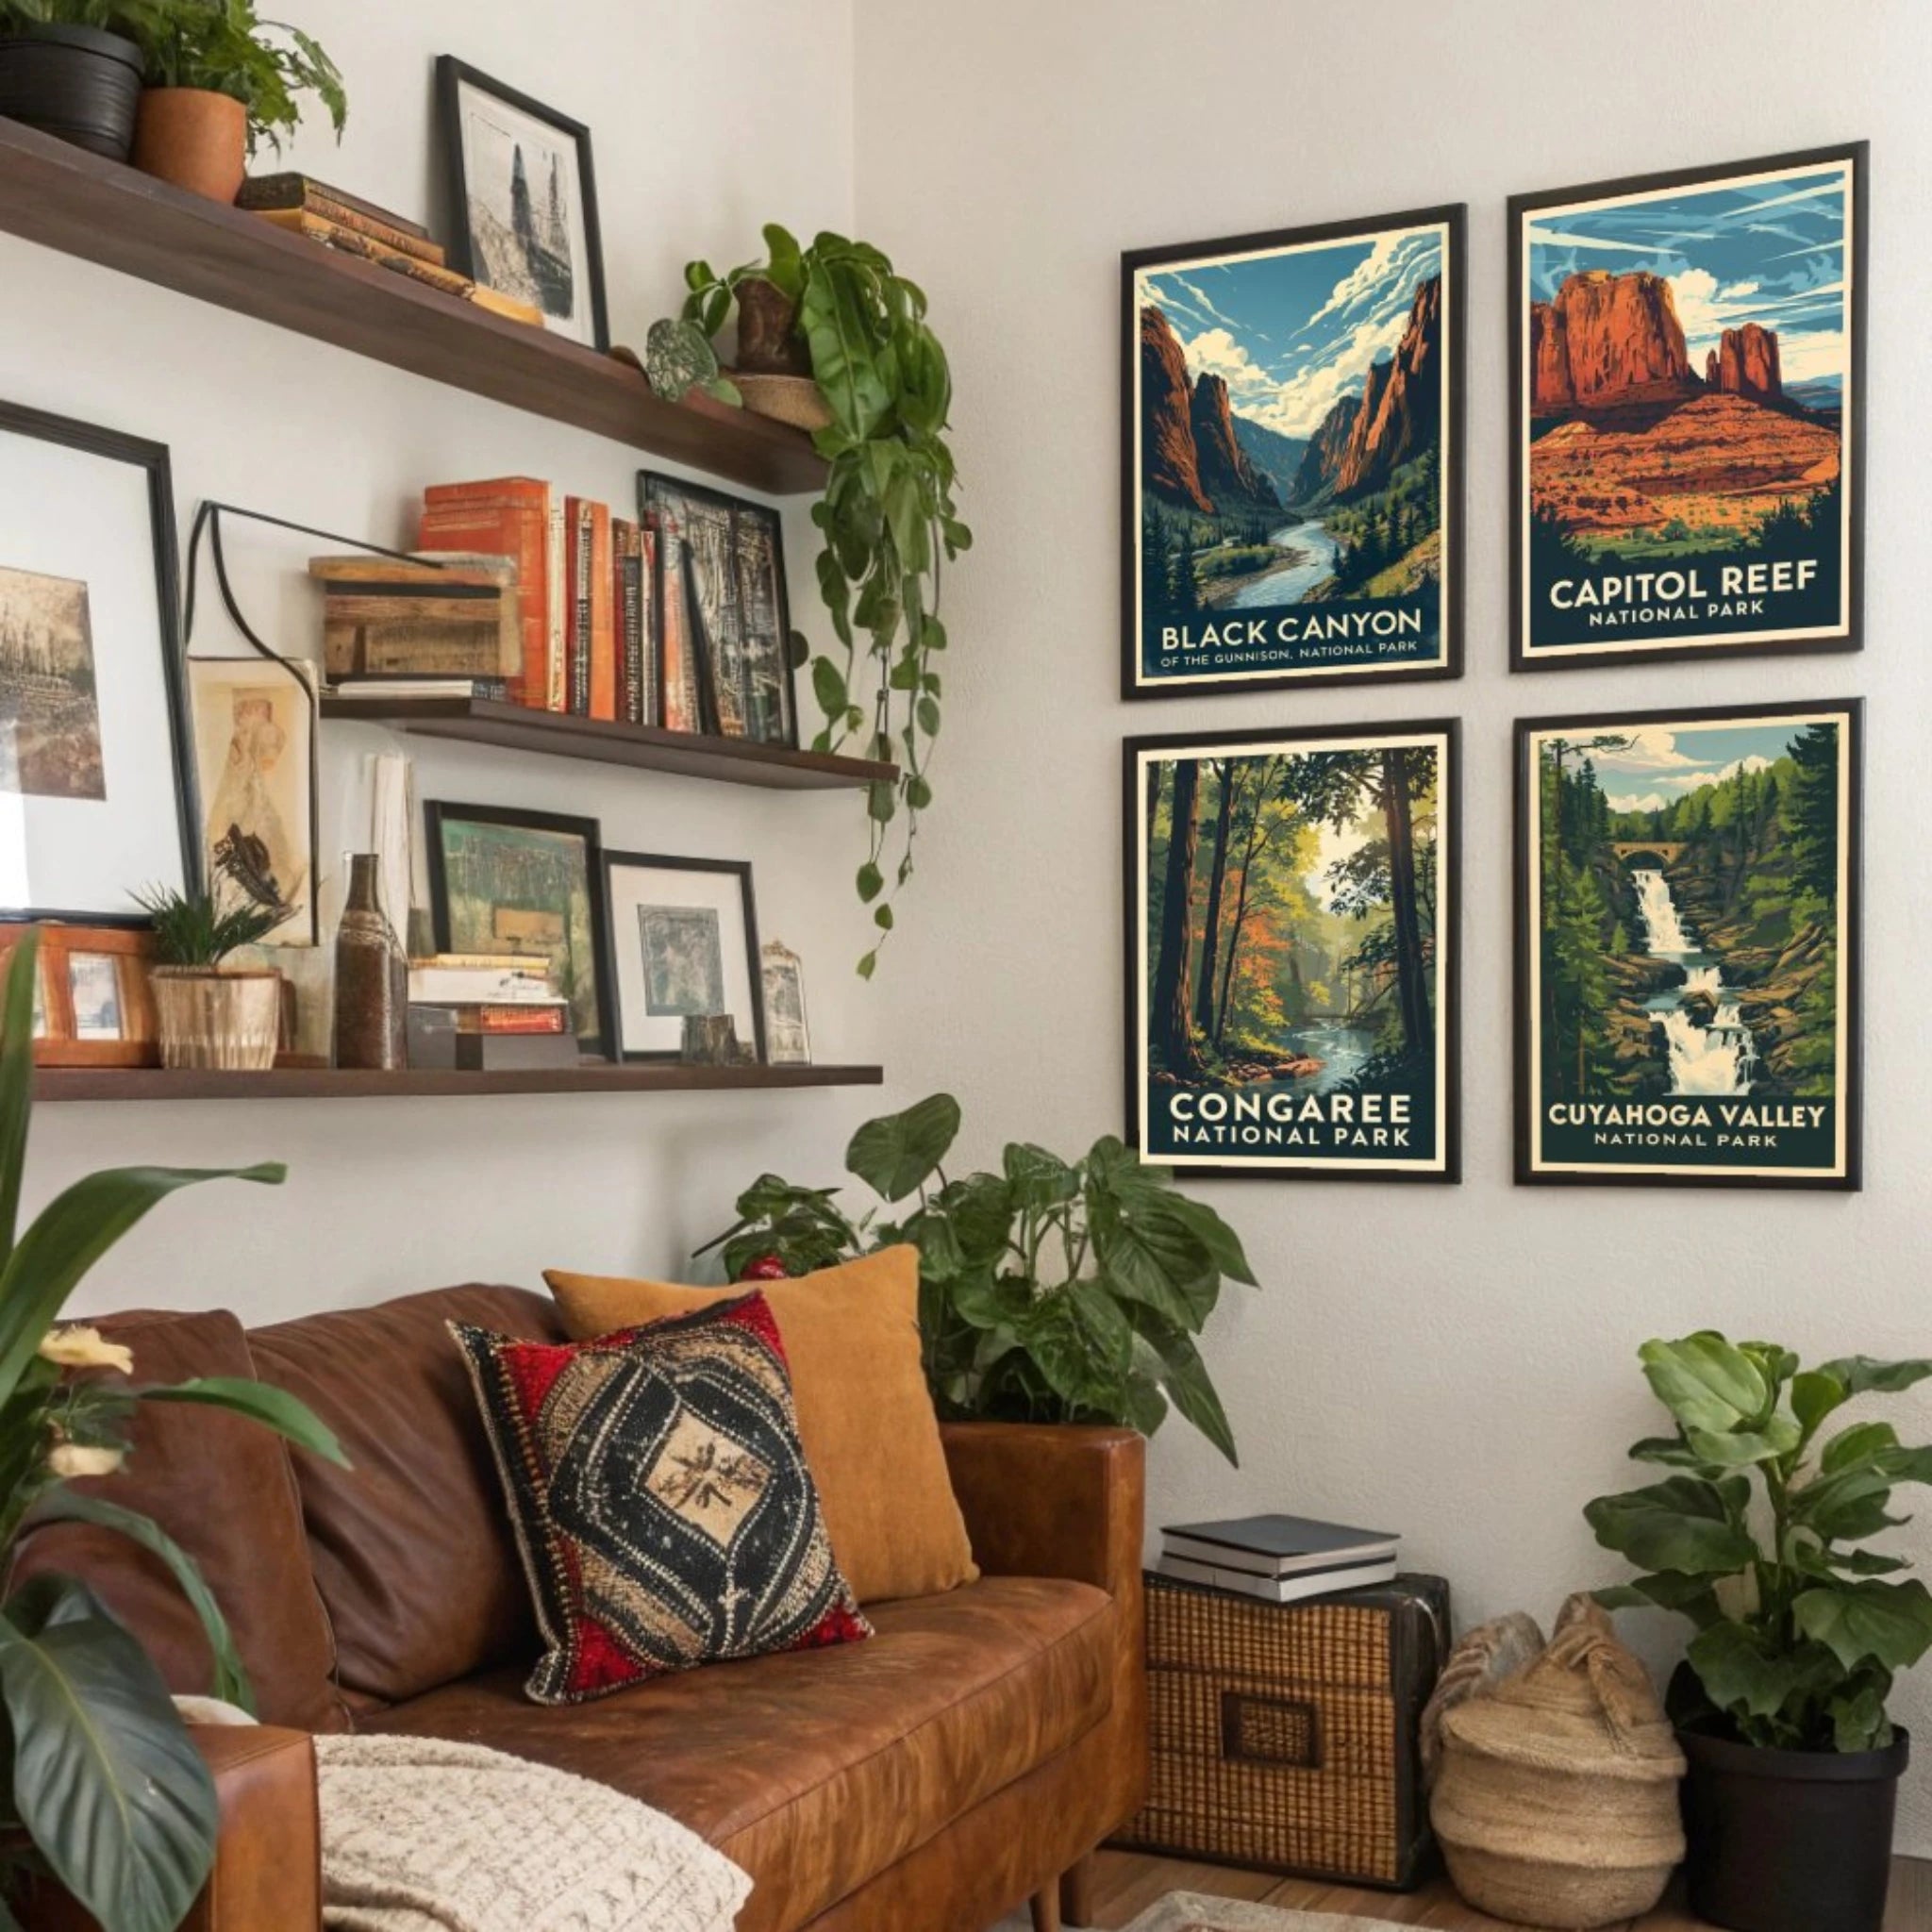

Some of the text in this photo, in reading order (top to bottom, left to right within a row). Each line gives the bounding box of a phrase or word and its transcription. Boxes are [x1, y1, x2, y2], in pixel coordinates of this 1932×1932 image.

[1550, 559, 1818, 608] CAPITOL REEF
[1590, 600, 1764, 626] NATIONAL PARK
[1162, 608, 1421, 650] BLACK CANYON
[1160, 657, 1179, 668] OF
[1184, 655, 1209, 665] THE
[1300, 644, 1373, 658] NATIONAL
[1379, 641, 1417, 653] PARK
[1170, 1093, 1411, 1124] CONGAREE
[1549, 1104, 1825, 1127] CUYAHOGA VALLEY
[1174, 1125, 1410, 1146] NATIONAL PARK
[1594, 1133, 1777, 1146] NATIONAL PARK
